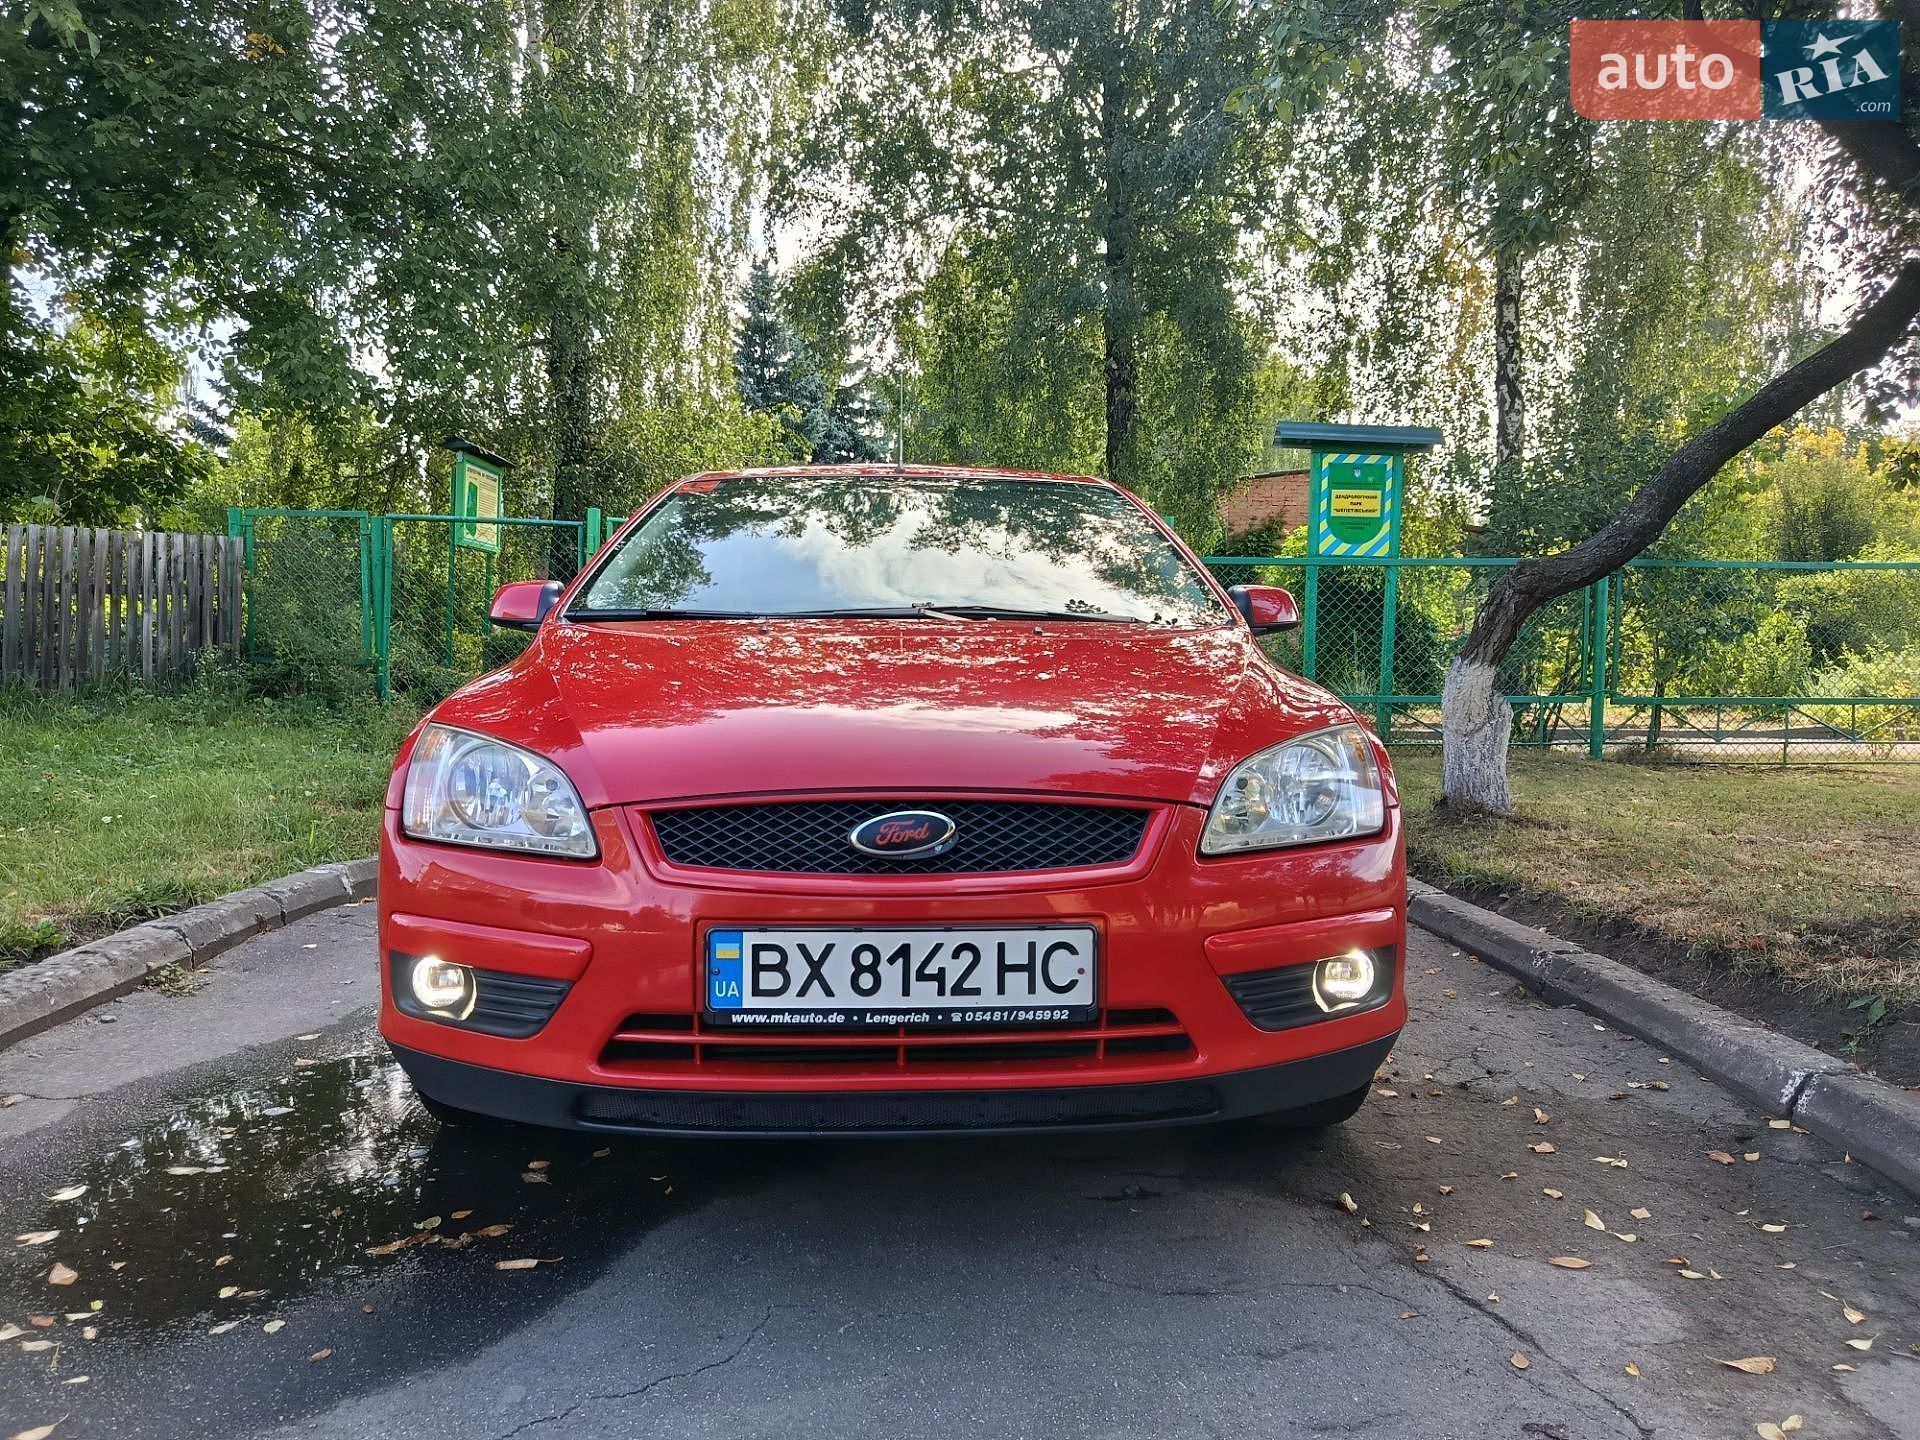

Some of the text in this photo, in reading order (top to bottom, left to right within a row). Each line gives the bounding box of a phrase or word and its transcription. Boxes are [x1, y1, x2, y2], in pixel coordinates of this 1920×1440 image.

[876, 819, 929, 845] Ford
[751, 941, 1080, 998] BX 8142 HC
[715, 980, 739, 997] UA
[731, 1010, 1070, 1025] www.mkauto.de Lengerich 05481/945992
